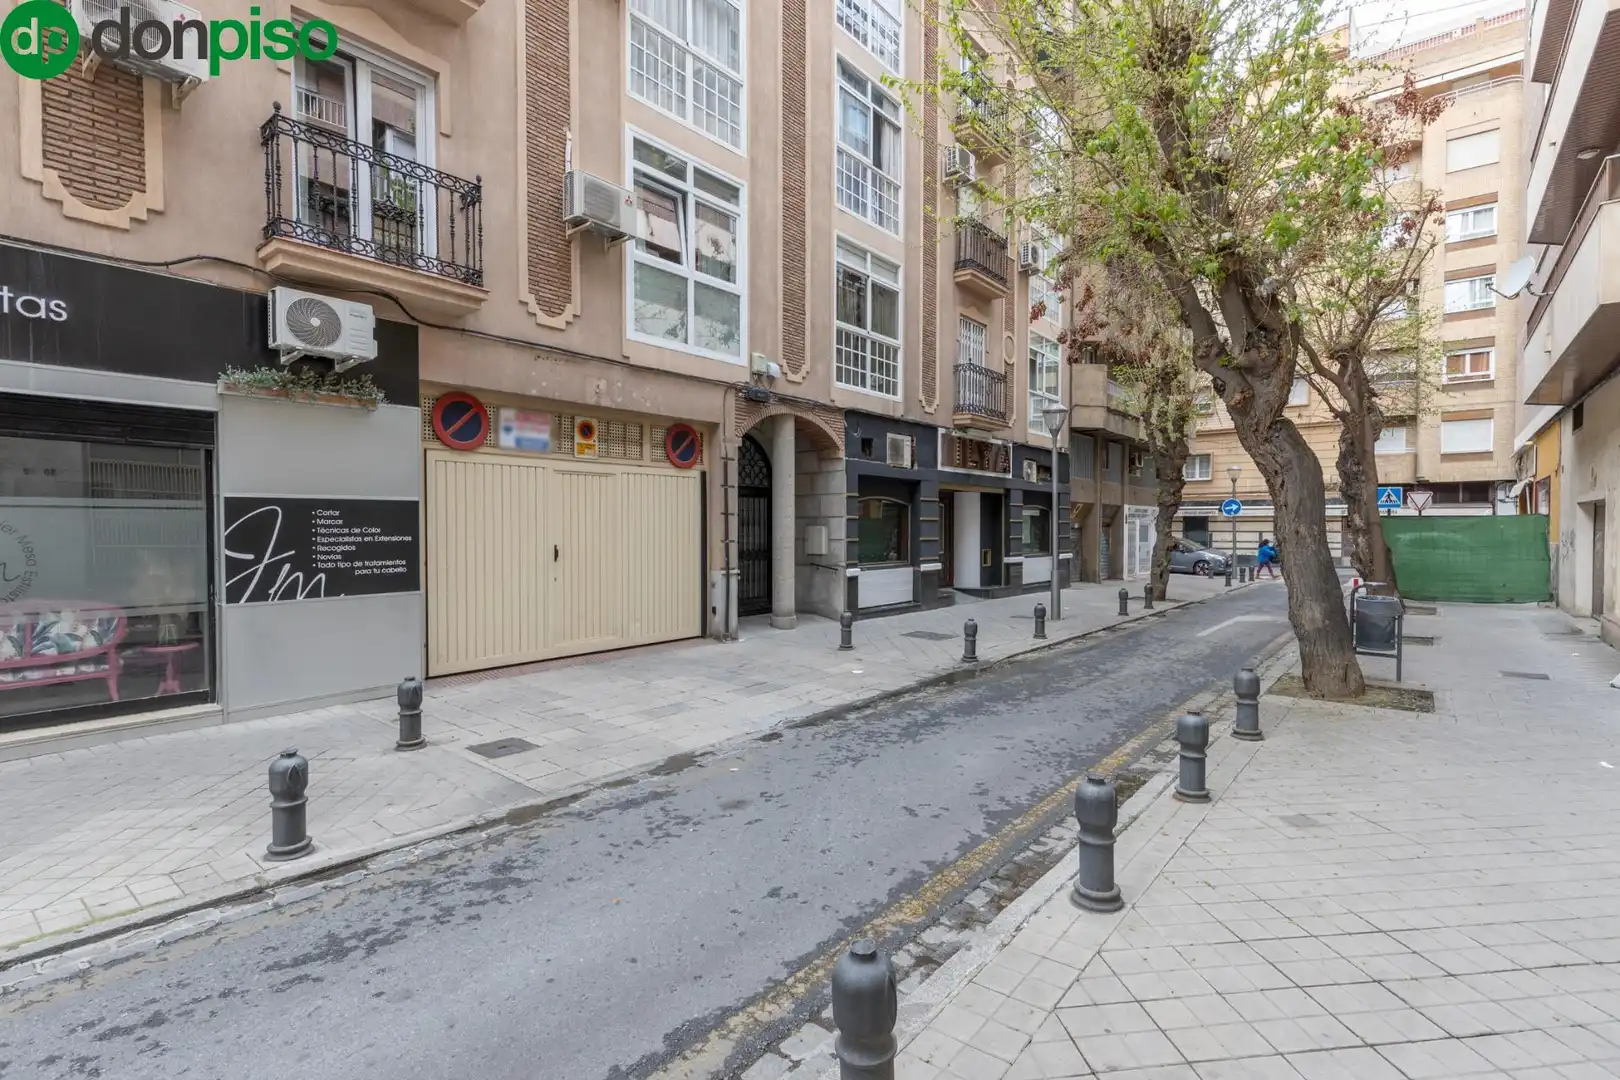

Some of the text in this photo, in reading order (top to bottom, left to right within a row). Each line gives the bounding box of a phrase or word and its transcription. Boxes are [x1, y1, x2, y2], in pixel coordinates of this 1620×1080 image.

[0, 285, 68, 322] tas
[316, 526, 381, 534] Técnicas de Color
[316, 544, 356, 552] Recogidos
[317, 561, 336, 569] Todo
[337, 561, 352, 569] tipo
[364, 559, 406, 567] tratamientos
[381, 566, 407, 574] cabello
